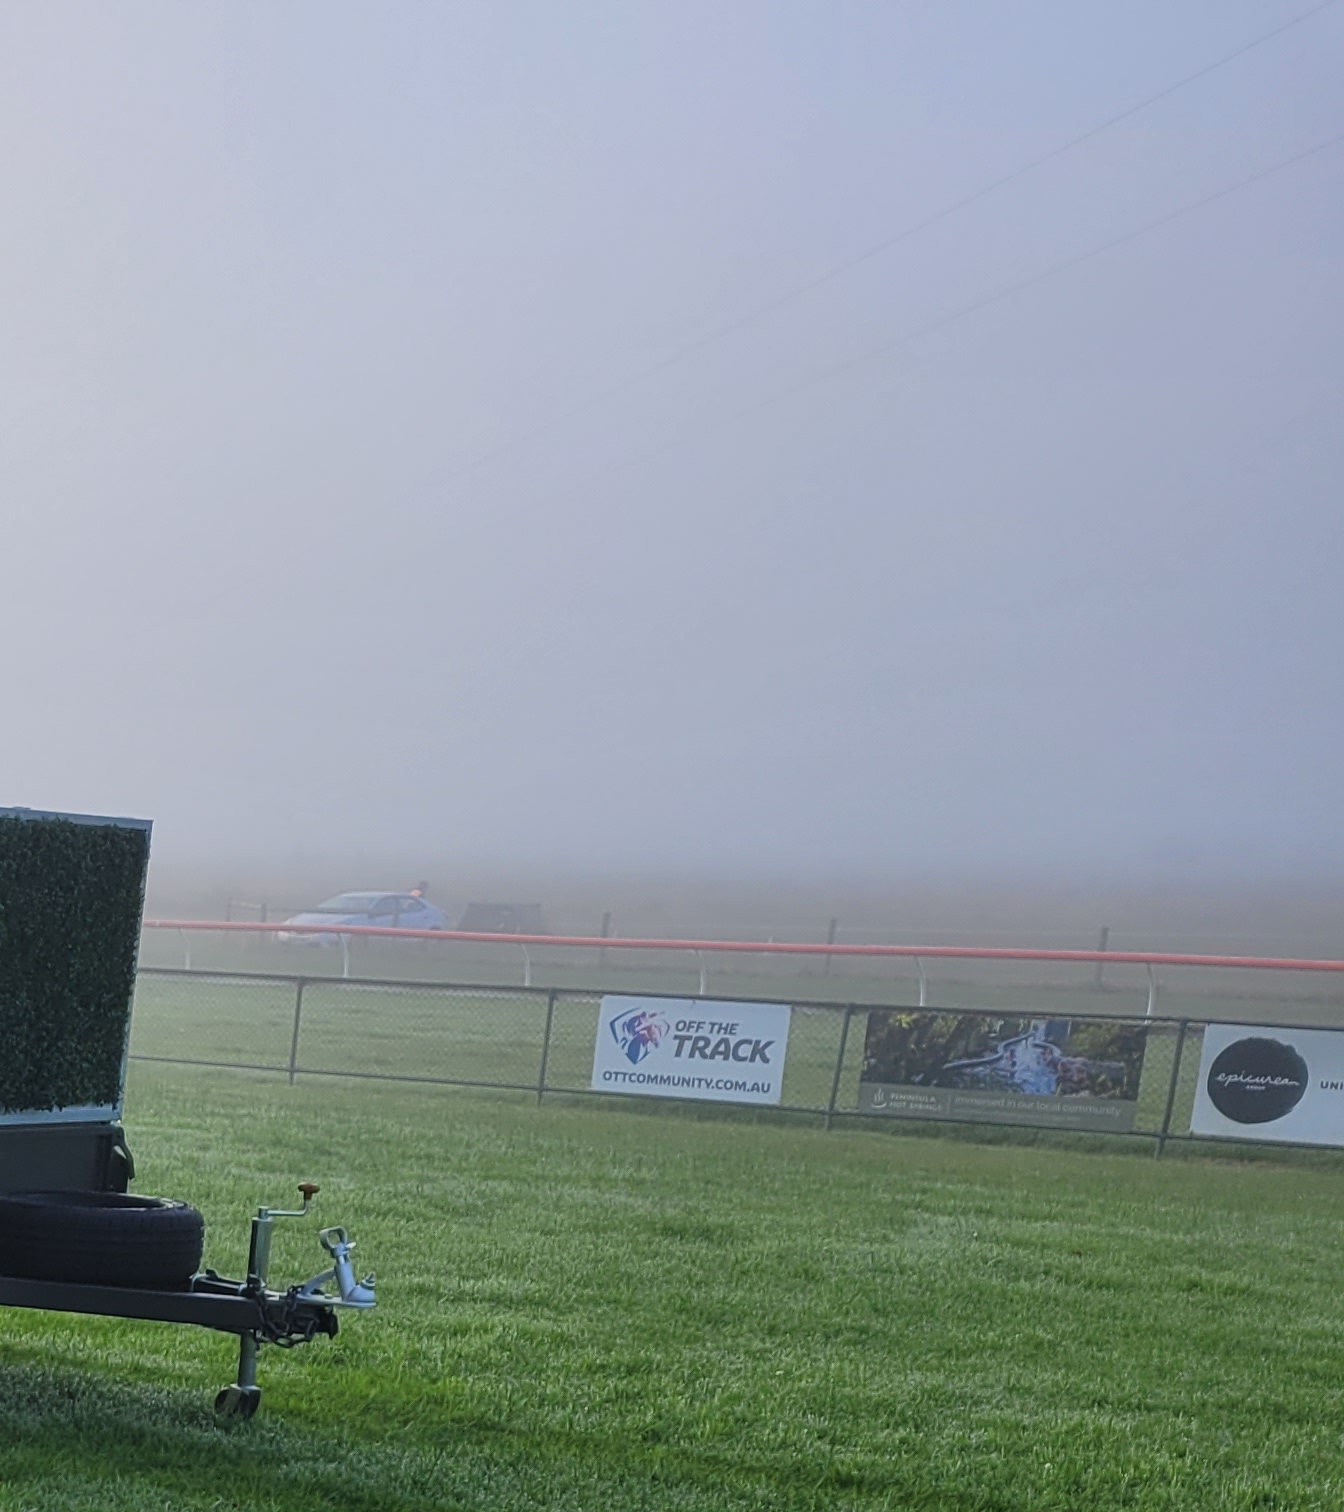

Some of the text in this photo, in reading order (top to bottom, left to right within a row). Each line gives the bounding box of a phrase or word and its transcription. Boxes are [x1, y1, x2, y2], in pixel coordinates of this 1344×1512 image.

[675, 1020, 739, 1035] OFF THE
[673, 1034, 775, 1064] TRACK
[603, 1071, 771, 1093] OTTCOMMUNITY.COM.AU
[1063, 1105, 1121, 1117] community
